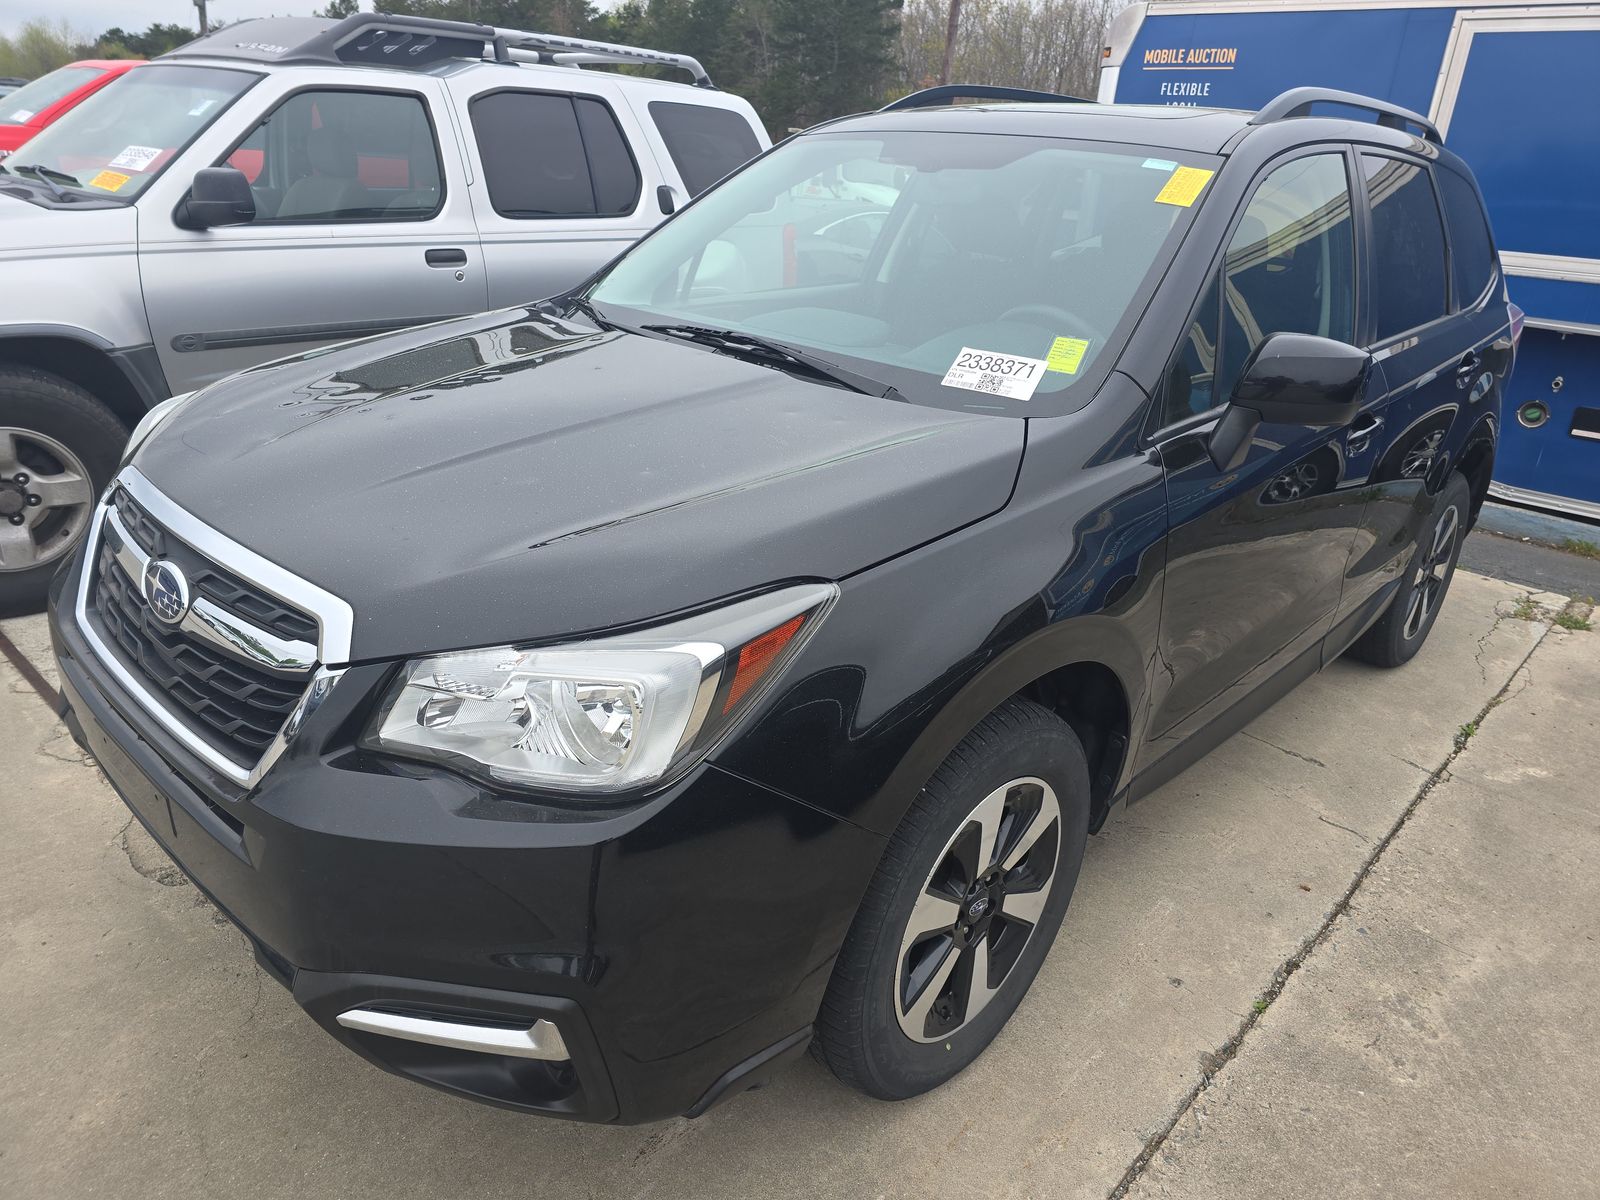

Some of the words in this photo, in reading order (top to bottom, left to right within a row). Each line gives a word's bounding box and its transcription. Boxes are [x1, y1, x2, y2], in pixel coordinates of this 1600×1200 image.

[1143, 49, 1185, 64] MOBILE
[1186, 48, 1237, 64] AUCTION
[1160, 83, 1211, 96] FLEXIBLE
[957, 353, 1037, 379] 2338371
